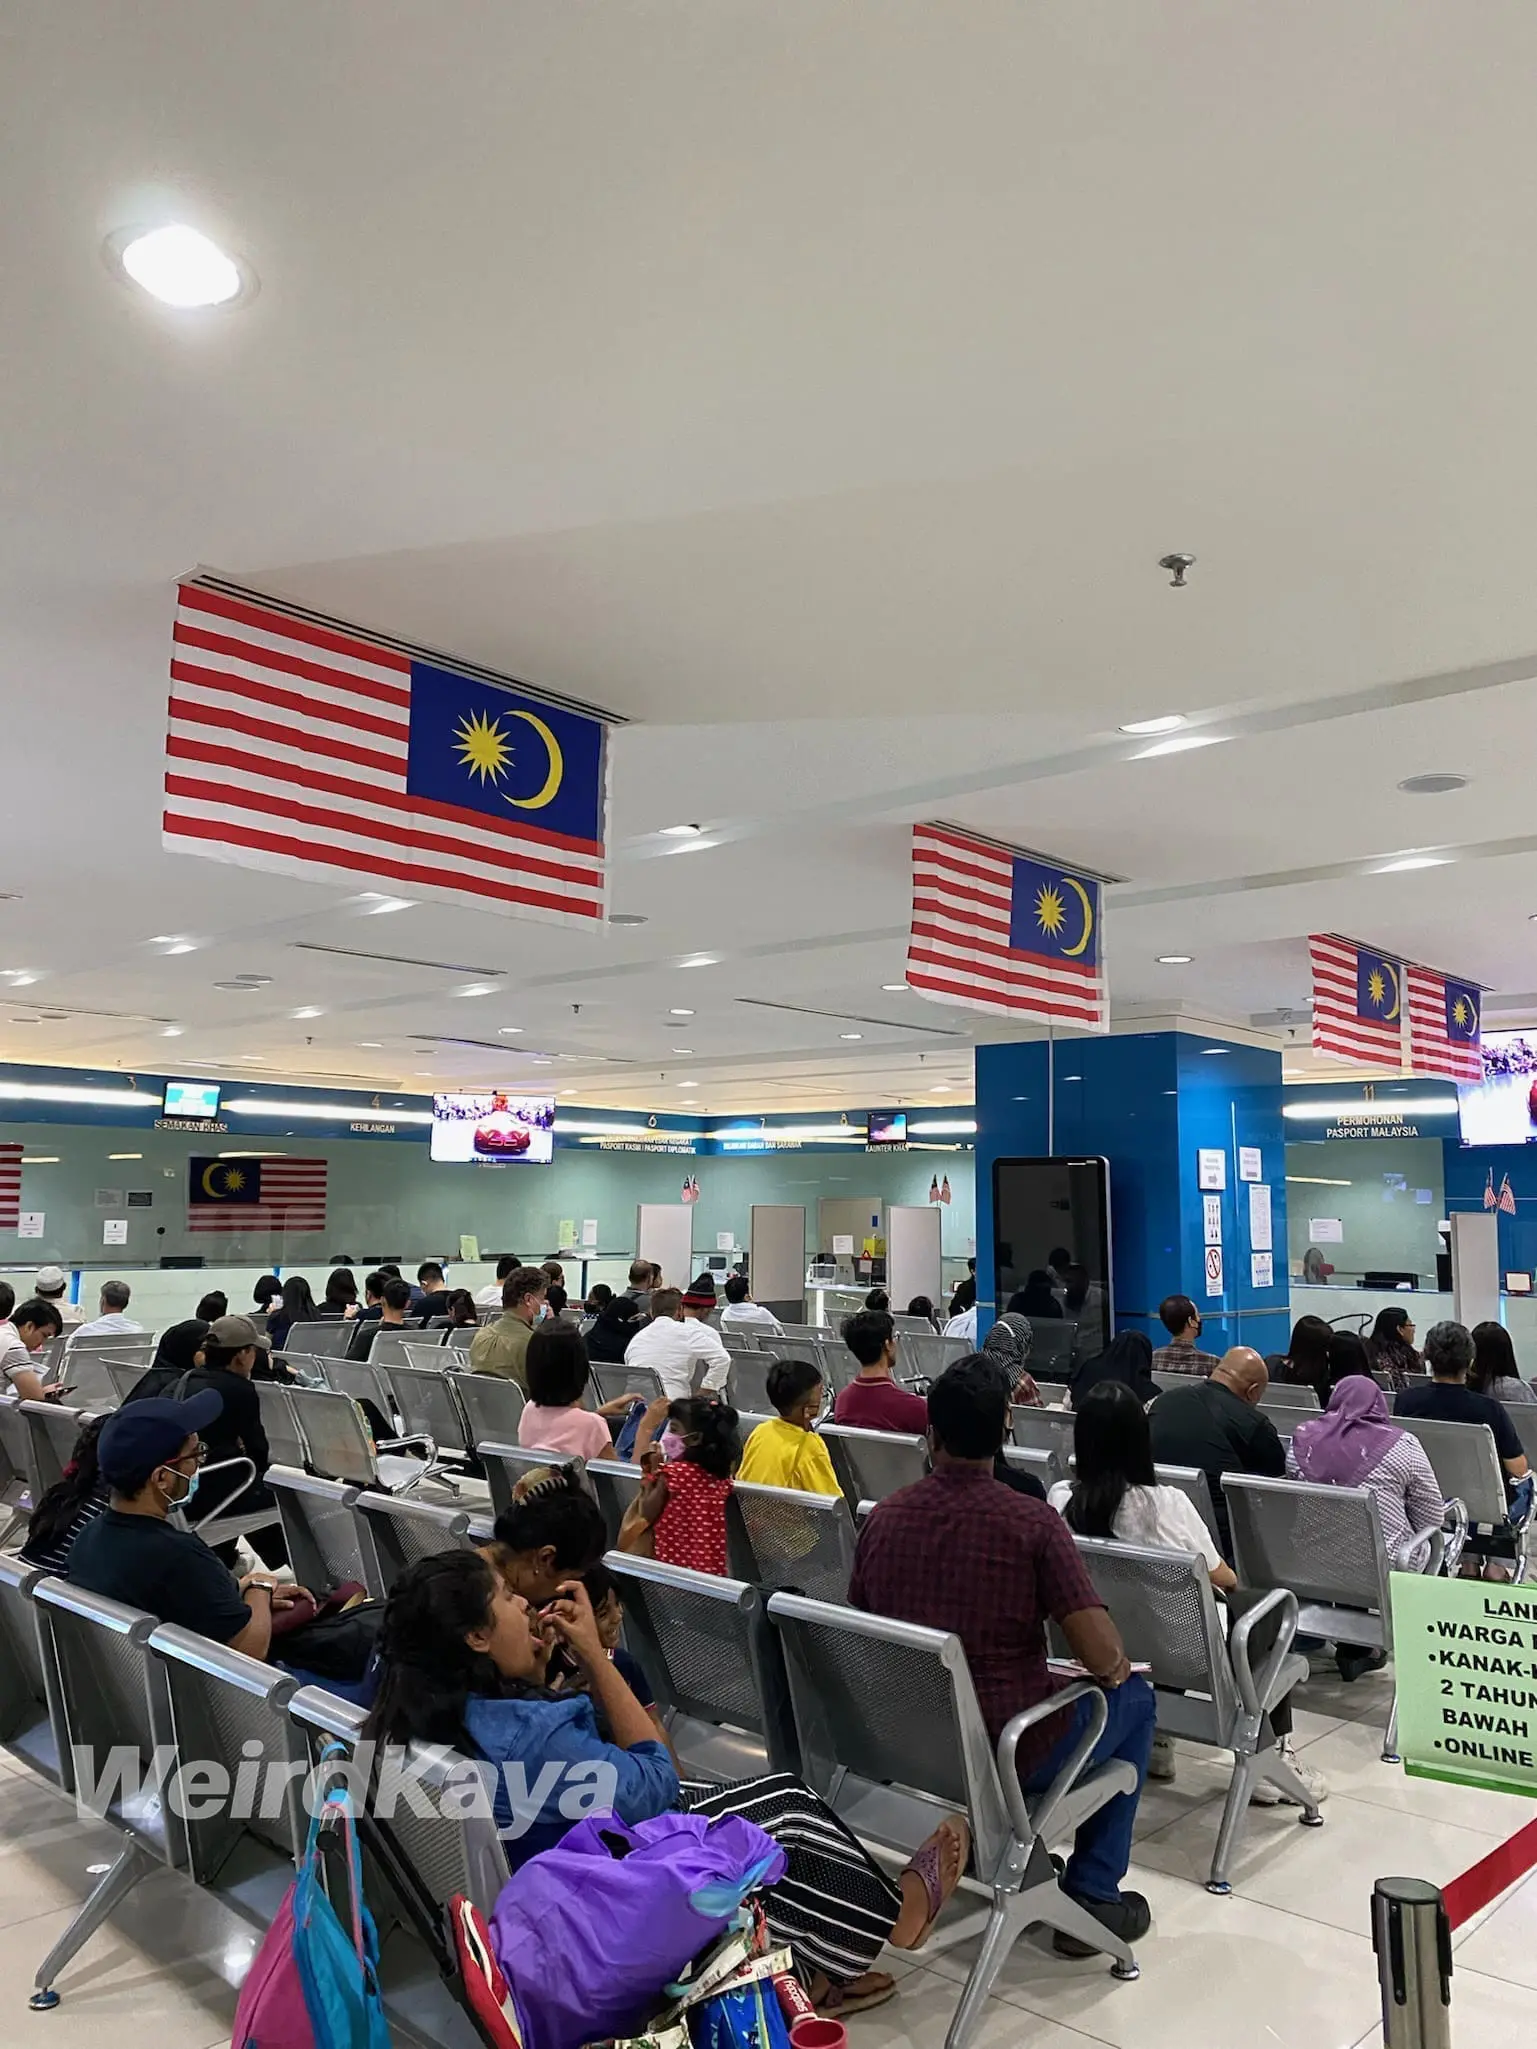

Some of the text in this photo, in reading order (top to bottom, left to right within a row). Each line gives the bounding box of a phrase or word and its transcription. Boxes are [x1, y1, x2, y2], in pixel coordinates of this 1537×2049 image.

[371, 1094, 381, 1110] 4
[648, 1114, 657, 1127] 6
[760, 1118, 766, 1131] 7
[1337, 1114, 1404, 1126] PERMOHONAN
[350, 1122, 396, 1134] KEHILANGAN
[1327, 1126, 1419, 1138] PASPORT MALAYSIA
[865, 1144, 892, 1153] KAUNTER
[1437, 1621, 1524, 1649] WARGA
[1441, 1680, 1453, 1695] 2
[1442, 1709, 1528, 1738] BAWAH
[1445, 1738, 1533, 1767] ONLINE
